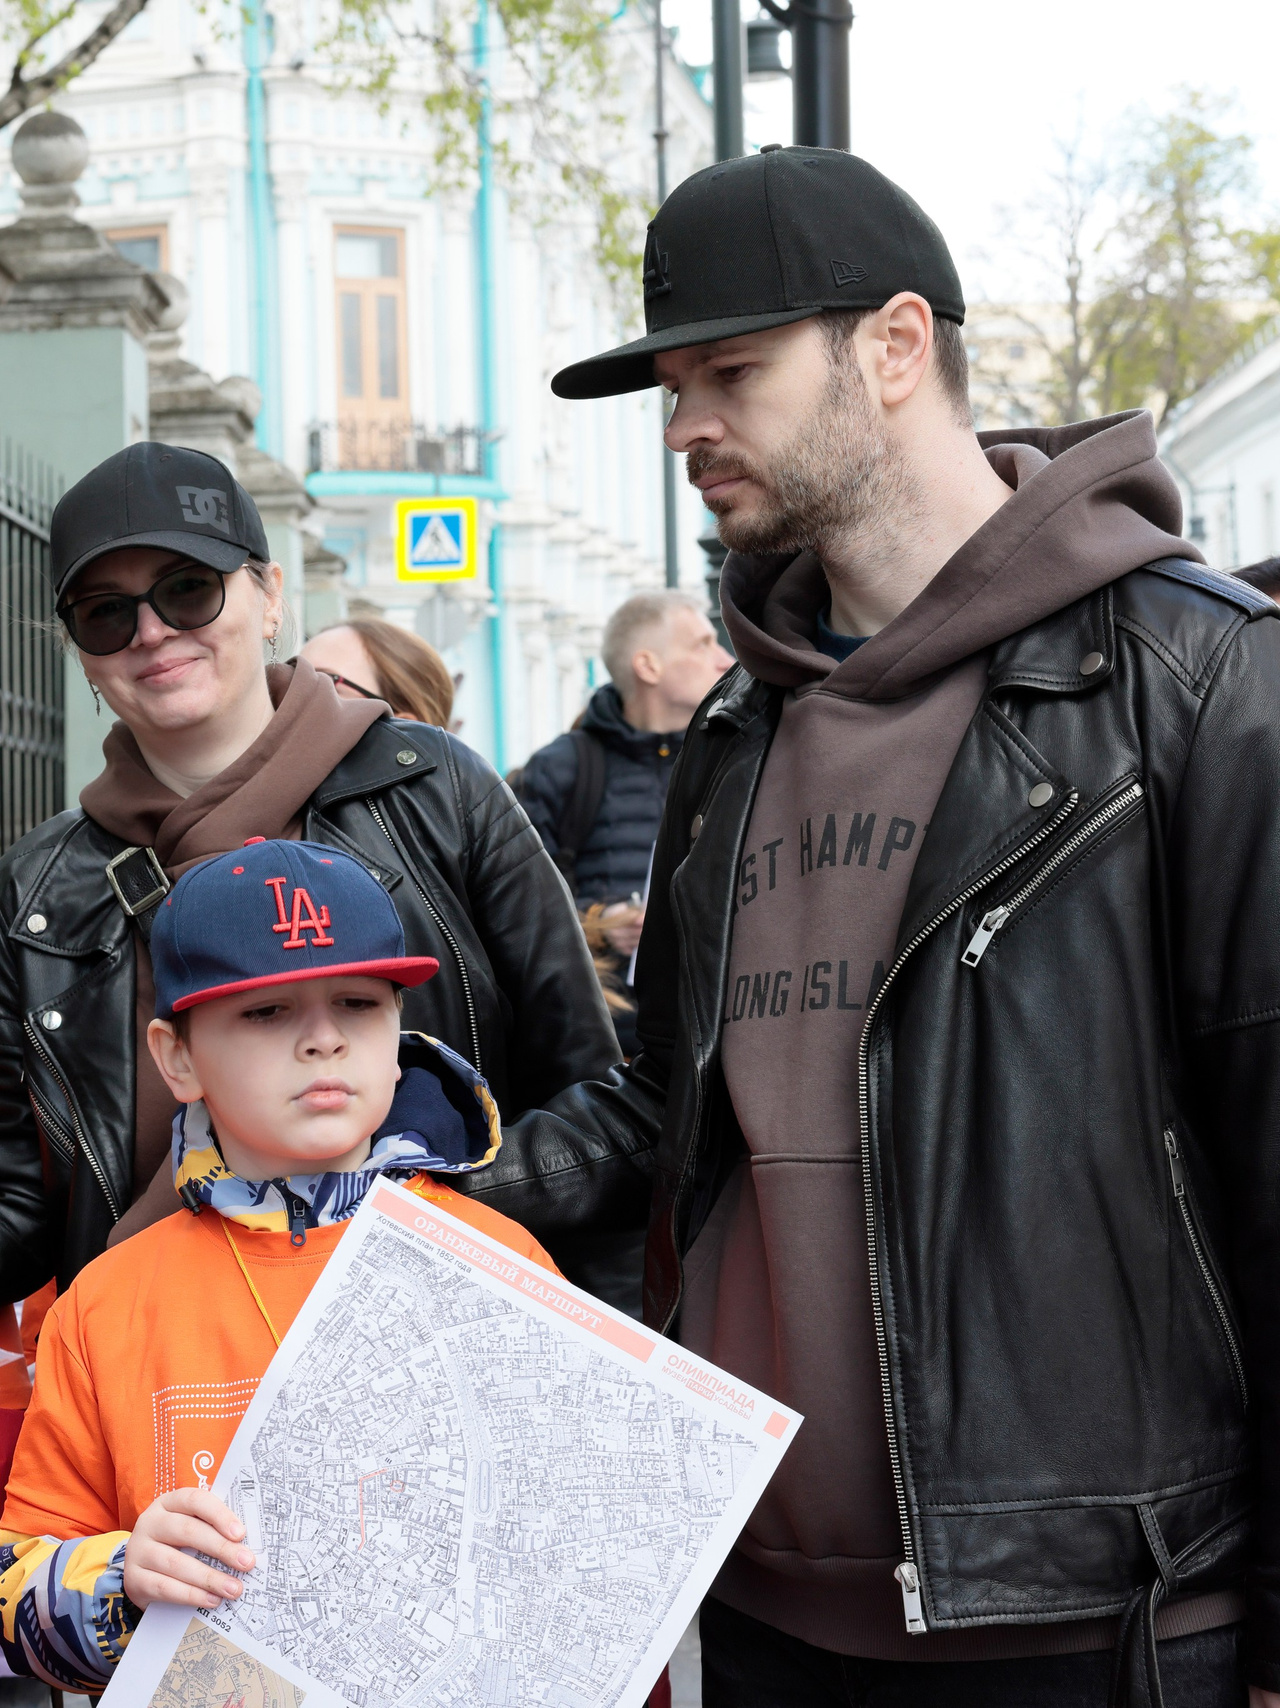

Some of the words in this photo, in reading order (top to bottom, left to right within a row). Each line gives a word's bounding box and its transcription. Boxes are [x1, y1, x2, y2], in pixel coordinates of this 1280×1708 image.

[175, 485, 230, 535] DC
[737, 837, 784, 910] ST
[799, 812, 926, 877] HAMP
[264, 877, 334, 949] LA
[726, 970, 792, 1024] ONG
[376, 1214, 414, 1240] Хотевский
[415, 1236, 434, 1252] план
[436, 1248, 455, 1264] 1852
[455, 1259, 472, 1274] года
[414, 1215, 520, 1283] ОРАНЖЕВЫЙ
[521, 1276, 602, 1329] МАРШРУТ
[661, 1365, 688, 1384] МУЗЕИ
[687, 1379, 715, 1400] ПАРКИ
[713, 1394, 751, 1420] УСАДЬБЫ
[667, 1354, 755, 1412] ОЛИМПИАДА
[196, 1607, 210, 1618] КП
[210, 1614, 232, 1633] 3052
